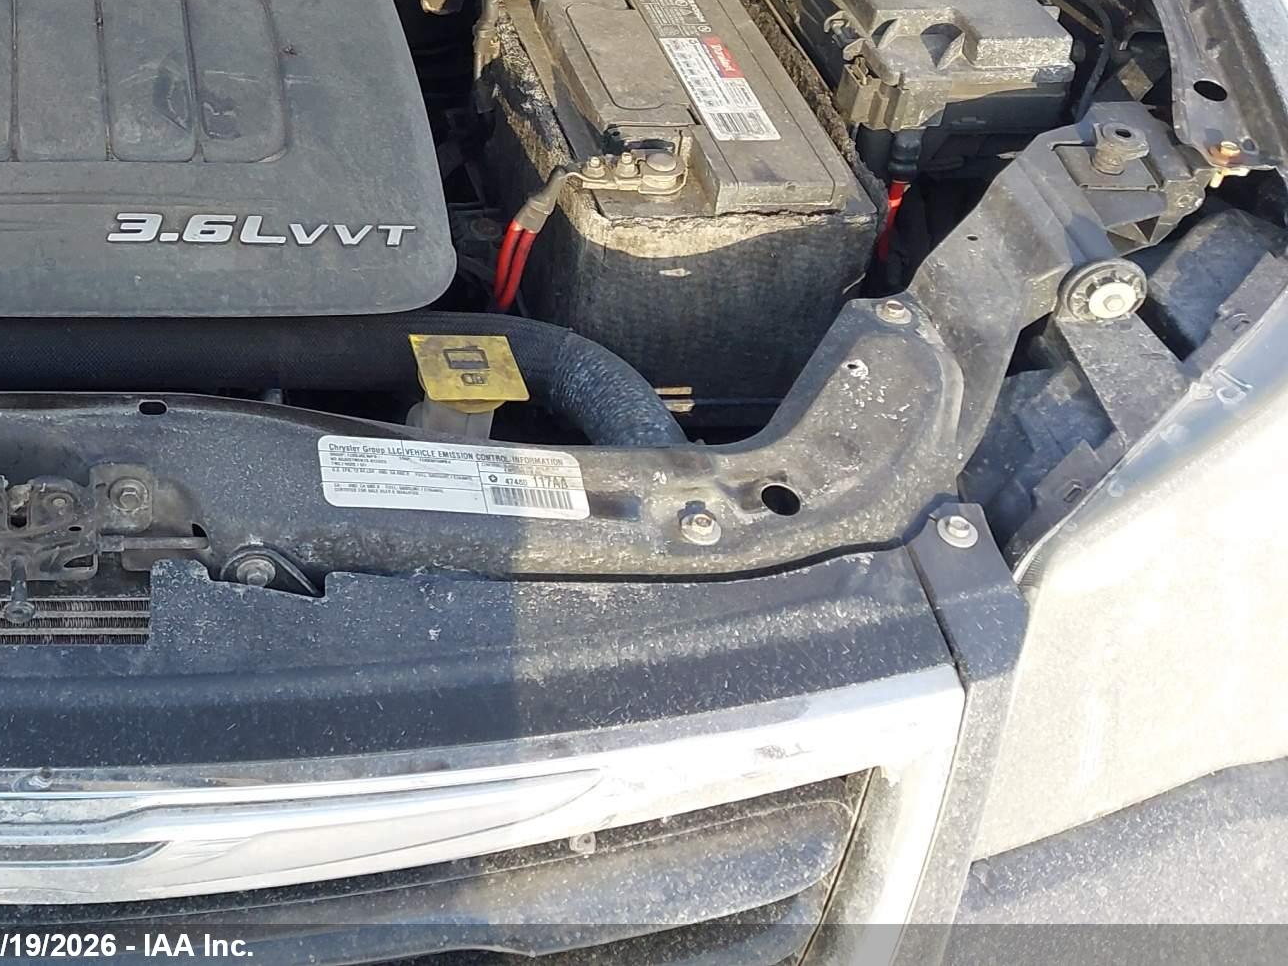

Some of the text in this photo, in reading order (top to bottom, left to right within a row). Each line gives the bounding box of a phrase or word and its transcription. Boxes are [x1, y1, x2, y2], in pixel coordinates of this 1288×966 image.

[328, 443, 360, 452] Chrysler
[362, 446, 385, 454] Group
[405, 448, 437, 457] VEHICLE
[438, 450, 474, 460] EMISSION
[476, 453, 509, 462] CONTROL
[511, 456, 564, 465] INFORMATION
